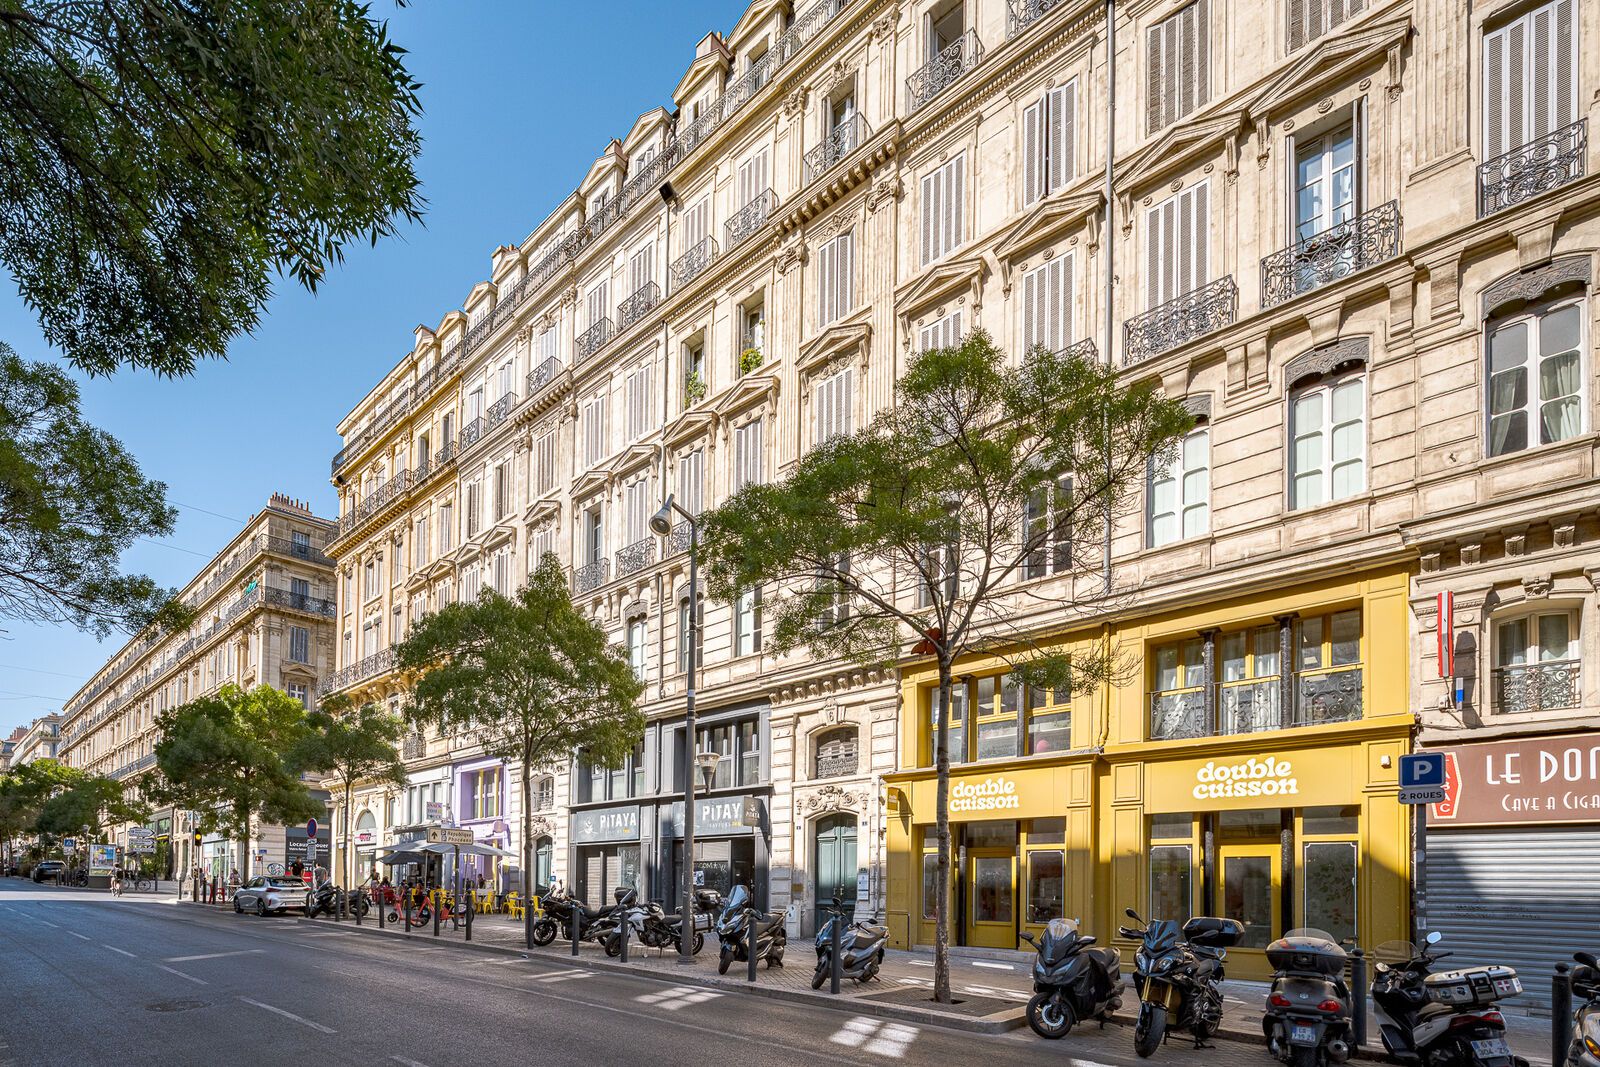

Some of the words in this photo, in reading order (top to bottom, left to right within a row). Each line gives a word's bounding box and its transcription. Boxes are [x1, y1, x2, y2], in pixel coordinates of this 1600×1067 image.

[1196, 756, 1293, 783] double
[1413, 760, 1433, 781] P
[1486, 753, 1521, 785] LE
[952, 777, 1015, 798] double
[1192, 777, 1300, 800] cuisson
[1410, 791, 1443, 800] ROUES
[702, 802, 742, 821] PiTAY
[949, 795, 1020, 812] cuisson
